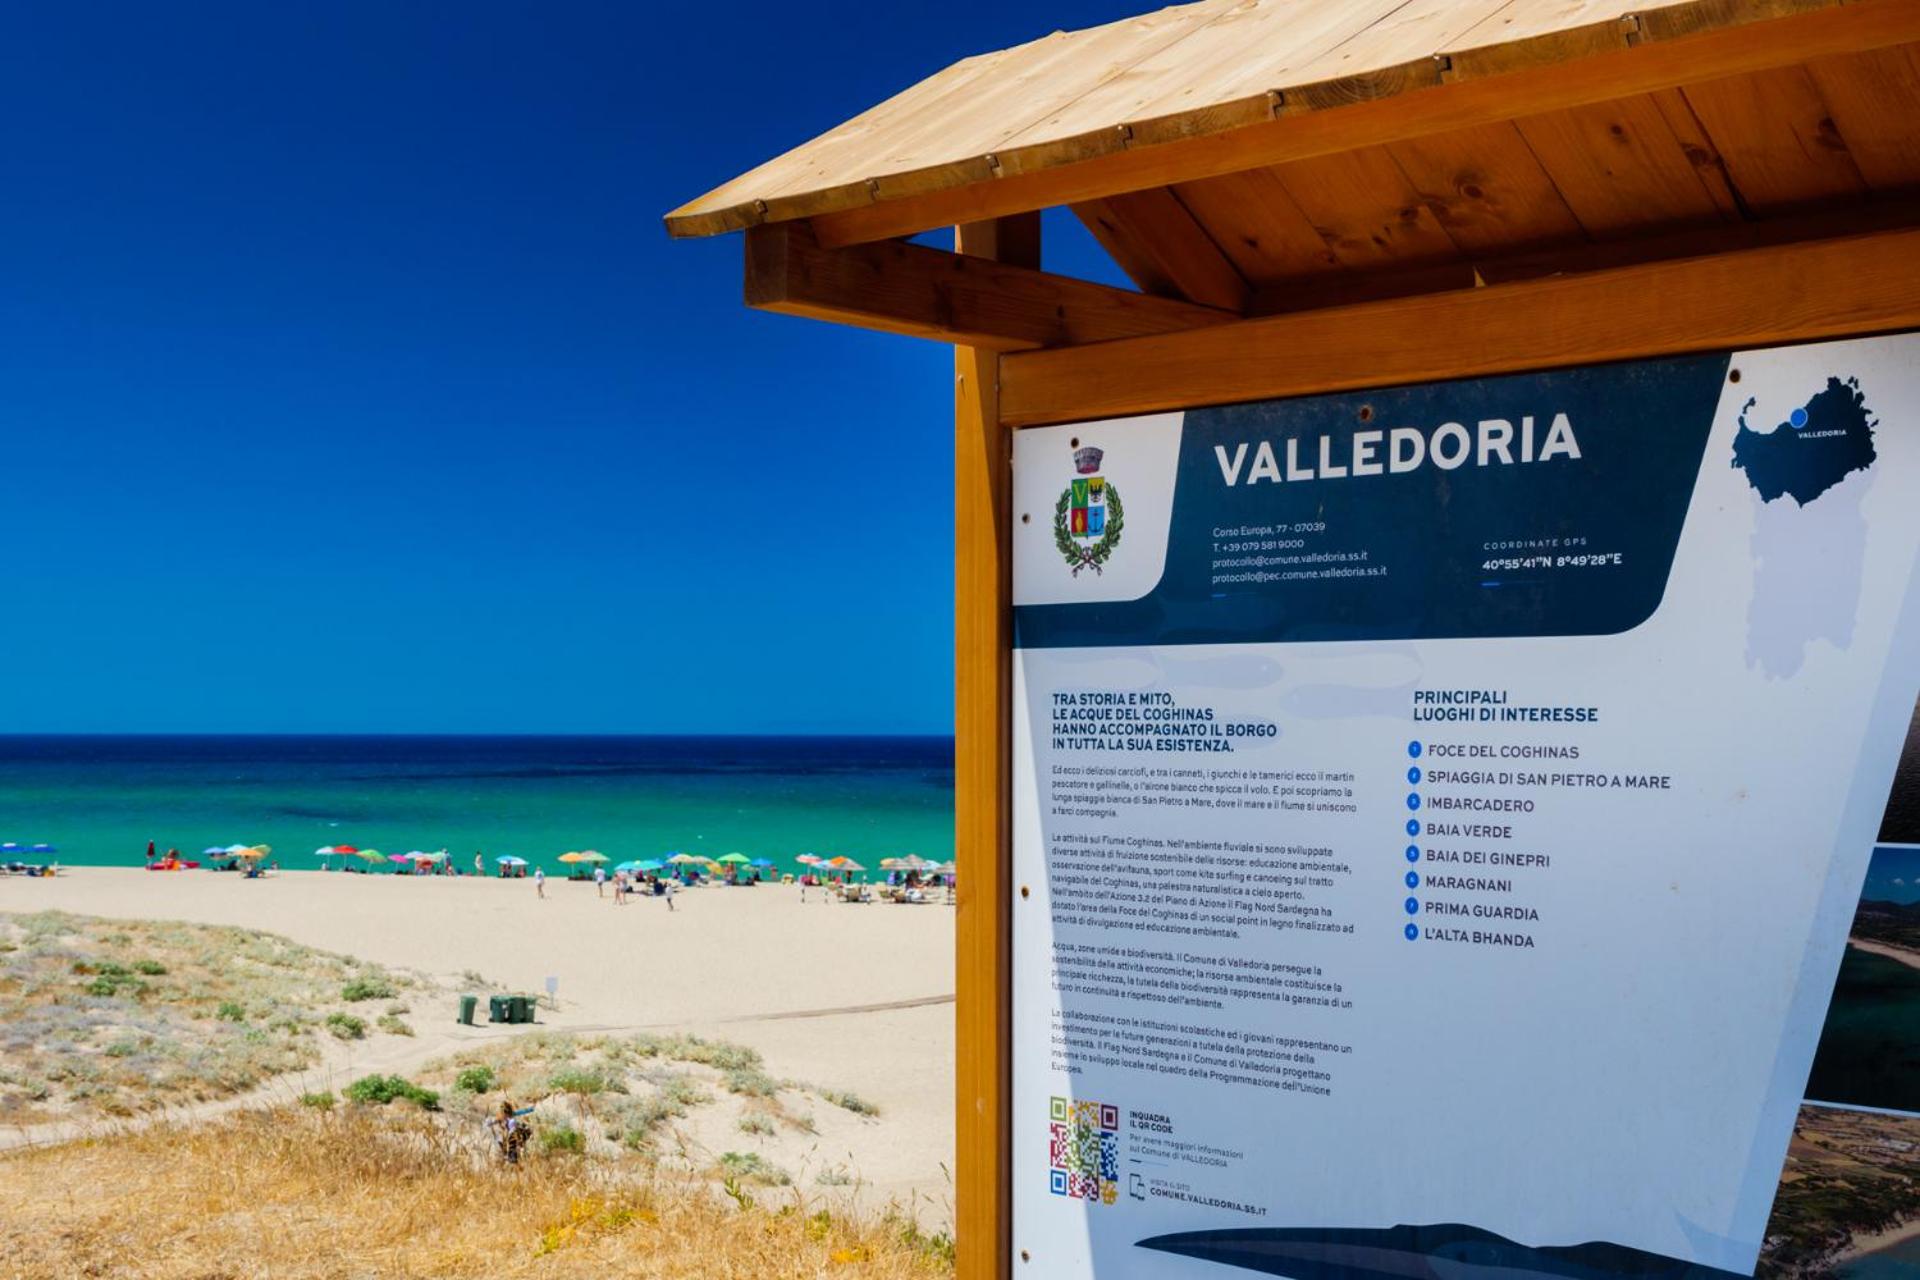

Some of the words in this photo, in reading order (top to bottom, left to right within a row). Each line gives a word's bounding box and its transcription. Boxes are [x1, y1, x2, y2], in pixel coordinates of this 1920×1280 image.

[1798, 429, 1846, 439] VALLEDORIA
[1214, 413, 1581, 487] VALLEDORIA
[1213, 527, 1239, 537] Corso
[1241, 525, 1274, 537] Europa,
[1295, 522, 1325, 532] 07039
[1223, 543, 1240, 551] +39
[1242, 542, 1259, 550] 079
[1261, 541, 1276, 549] 581
[1278, 540, 1304, 549] 9000
[1483, 539, 1558, 550] COORDINATE
[1564, 538, 1587, 546] GPS
[1212, 551, 1368, 569] protocollo@comune.valledoria.ss.it
[1212, 566, 1387, 583] protocollo@pec.comune.valledoria.ss.it
[1053, 694, 1077, 705] TRA
[1079, 694, 1126, 705] STORIA
[1129, 694, 1136, 704] E
[1140, 693, 1175, 707] MITO,
[1414, 691, 1507, 704] PRINCIPALI
[1053, 709, 1067, 720] LE
[1070, 709, 1113, 721] ACQUE
[1116, 709, 1140, 720] DEL
[1143, 708, 1213, 720] COGHINAS
[1414, 708, 1474, 722] LUOGHI
[1480, 708, 1496, 722] DI
[1501, 708, 1598, 722] INTERESSE
[1053, 723, 1097, 735] HANNO
[1100, 724, 1207, 736] ACCOMPAGNATO
[1211, 725, 1223, 736] IL
[1226, 725, 1277, 737] BORGO
[1053, 738, 1064, 749] IN
[1067, 738, 1105, 750] TUTTA
[1109, 739, 1124, 750] LA
[1127, 739, 1153, 750] SUA
[1157, 739, 1234, 752] ESISTENZA.
[1428, 744, 1465, 758] FOCE
[1470, 745, 1496, 758] DEL
[1500, 746, 1579, 759] COGHINAS
[1428, 771, 1495, 785] SPIAGGIA
[1499, 772, 1513, 786] DI
[1517, 773, 1547, 786] SAN
[1551, 774, 1607, 788] PIETRO
[1610, 775, 1621, 788] A
[1626, 776, 1670, 789] MARE
[1281, 785, 1294, 797] poi
[1296, 786, 1342, 799] scopriamo
[1427, 797, 1534, 813] IMBARCADERO
[1427, 824, 1460, 837] BAIA
[1463, 824, 1512, 838] VERDE
[1250, 857, 1297, 869] educazione
[1427, 850, 1459, 863] BAIA
[1463, 851, 1486, 864] DEI
[1490, 852, 1550, 867] GINEPRI
[1426, 876, 1512, 892] MARAGNANI
[1426, 902, 1470, 917] PRIMA
[1473, 904, 1539, 921] GUARDIA
[1425, 928, 1469, 943] L'ALTA
[1473, 930, 1535, 948] BHANDA
[1272, 964, 1312, 975] persegue
[1130, 1111, 1170, 1124] INQUADRA
[1138, 1122, 1150, 1130] QR
